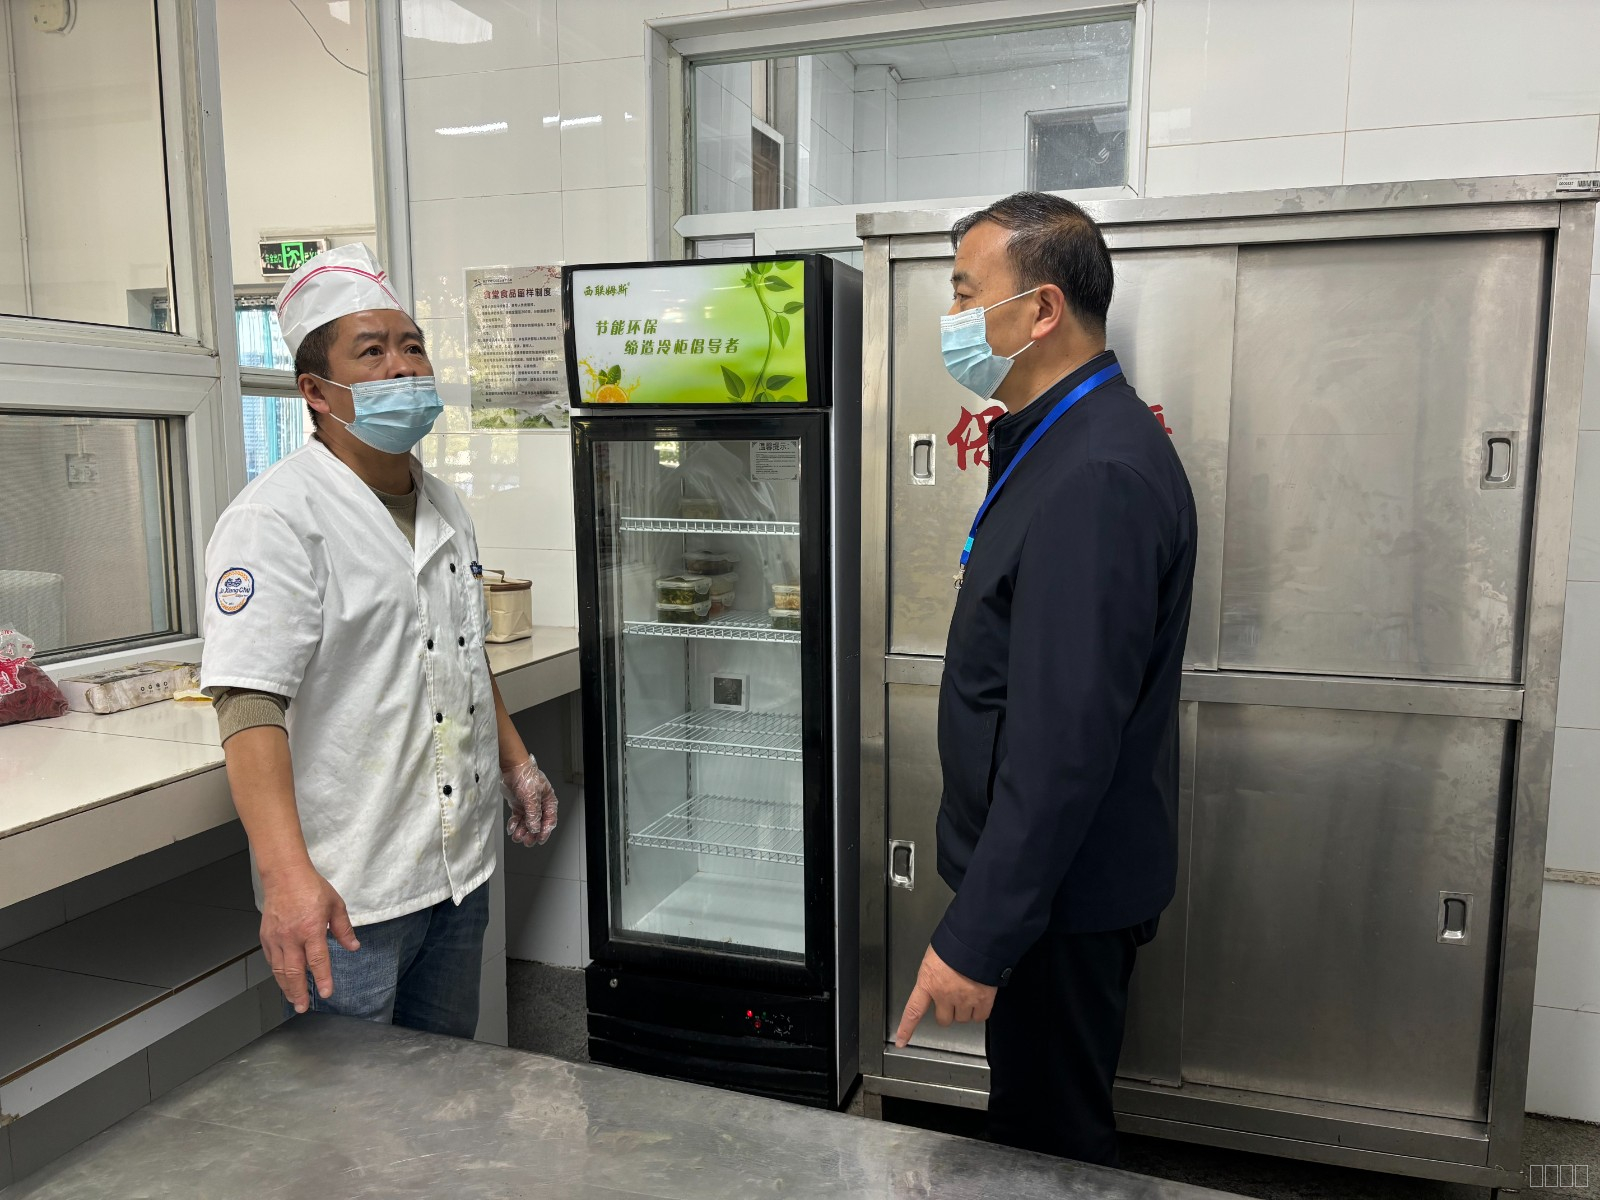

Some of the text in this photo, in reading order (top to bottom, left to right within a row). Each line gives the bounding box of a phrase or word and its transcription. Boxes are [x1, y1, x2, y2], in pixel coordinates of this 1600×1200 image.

[484, 287, 552, 300] 食堂食品留样制度
[583, 283, 628, 298] 西联姆斯
[596, 319, 659, 336] 节能环保
[624, 337, 739, 356] 缔造冷柜倡导者
